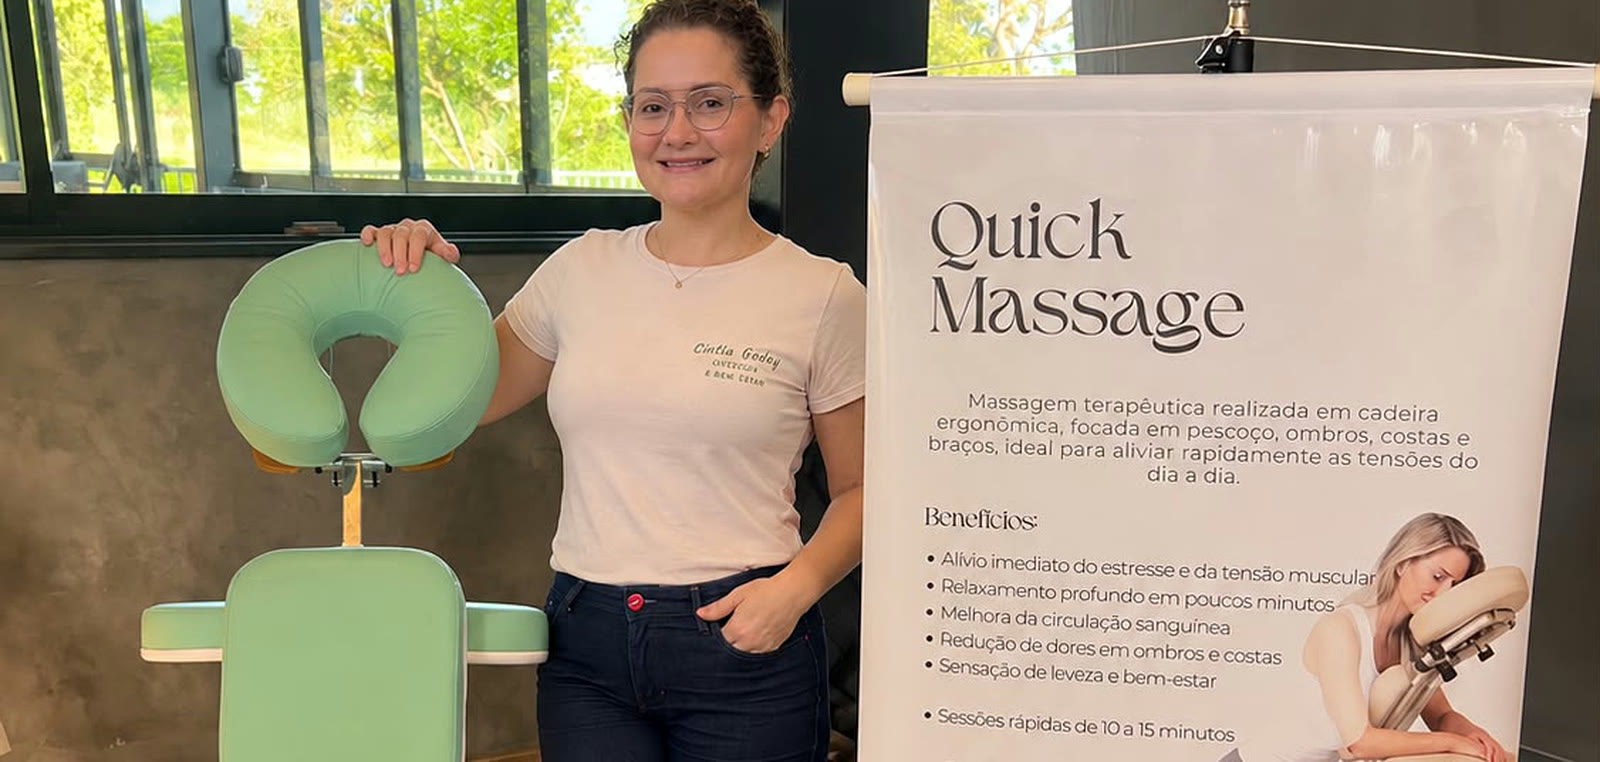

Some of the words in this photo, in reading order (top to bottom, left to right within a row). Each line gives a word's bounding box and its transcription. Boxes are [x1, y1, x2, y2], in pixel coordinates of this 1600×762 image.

[931, 198, 1132, 271] Quick
[930, 276, 1246, 354] Massage
[741, 347, 780, 372] Godoy
[968, 394, 1076, 414] Massagem
[1083, 398, 1204, 417] terapêutica
[1212, 400, 1308, 418] realizada
[1316, 407, 1350, 419] em
[1357, 405, 1438, 422] cadeira
[936, 417, 1063, 436] ergonômica,
[1070, 418, 1139, 436] focada
[1146, 425, 1179, 437] em
[1187, 426, 1278, 444] pescoço,
[1285, 425, 1373, 446] ombros,
[1380, 430, 1450, 445] costas
[1456, 433, 1470, 446] e
[928, 435, 998, 456] braços,
[1005, 438, 1052, 455] ideal
[1060, 444, 1105, 460] para
[1112, 442, 1174, 459] aliviar
[1182, 445, 1321, 465] rapidamente
[1327, 453, 1351, 465] as
[1357, 451, 1443, 468] tensões
[1448, 452, 1478, 469] do
[1147, 466, 1178, 482] dia
[1185, 471, 1196, 483] a
[1203, 467, 1239, 484] dia.
[940, 552, 987, 568] Alívio
[991, 554, 1070, 573] imediato
[1072, 558, 1097, 574] do
[1100, 562, 1175, 577] estresse
[1178, 567, 1190, 578] e
[1193, 563, 1217, 579] da
[1221, 566, 1284, 582] tensão
[1288, 569, 1376, 585] muscular
[941, 578, 1056, 599] Relaxamento
[1060, 586, 1145, 603] profundo
[1147, 593, 1179, 605] em
[1184, 594, 1253, 609] poucos
[1256, 595, 1335, 612] minutos
[940, 606, 1011, 624] Melhora
[1014, 610, 1037, 626] da
[1041, 612, 1132, 633] circulação
[940, 632, 1016, 654] Redução
[1019, 637, 1042, 653] de
[1045, 638, 1096, 656] dores
[1098, 645, 1129, 657] em
[1133, 644, 1205, 661] ombros
[1207, 650, 1220, 662] e
[1223, 651, 1282, 665] costas
[938, 658, 1021, 680] Sensação
[1023, 664, 1047, 679] de
[1050, 665, 1103, 682] leveza
[1107, 672, 1119, 683] e
[1123, 669, 1217, 688] bem-estar
[937, 709, 1005, 728] Sessões
[1008, 715, 1071, 733] rápidas
[1073, 719, 1098, 734] de
[1100, 720, 1120, 735] 10
[1123, 725, 1133, 736] a
[1137, 722, 1155, 737] 15
[1158, 724, 1235, 742] minutos
